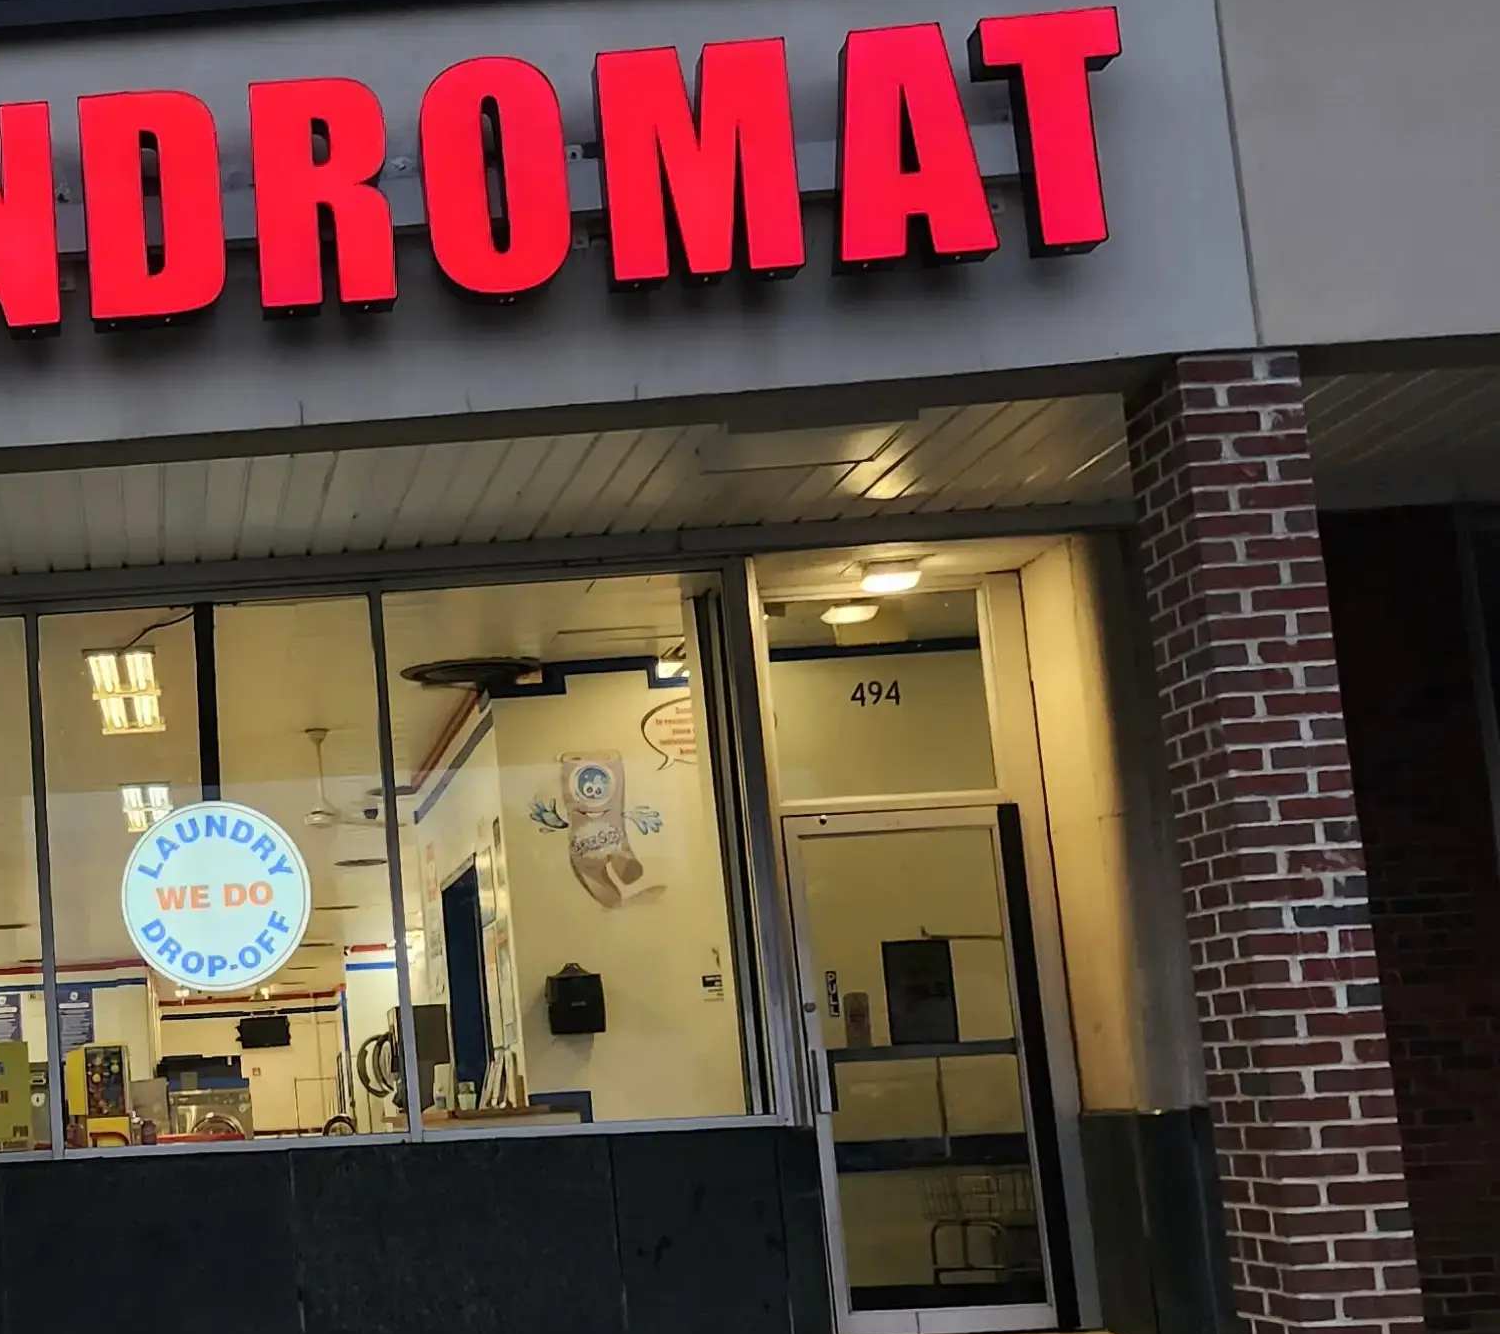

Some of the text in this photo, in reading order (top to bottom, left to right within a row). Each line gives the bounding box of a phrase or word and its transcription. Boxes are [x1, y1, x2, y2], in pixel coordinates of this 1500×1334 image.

[850, 679, 901, 707] 494
[137, 814, 294, 880] LAUNDRY
[155, 881, 274, 911] WE DO
[140, 910, 290, 978] DROP-OFF
[827, 972, 841, 1016] PULL
